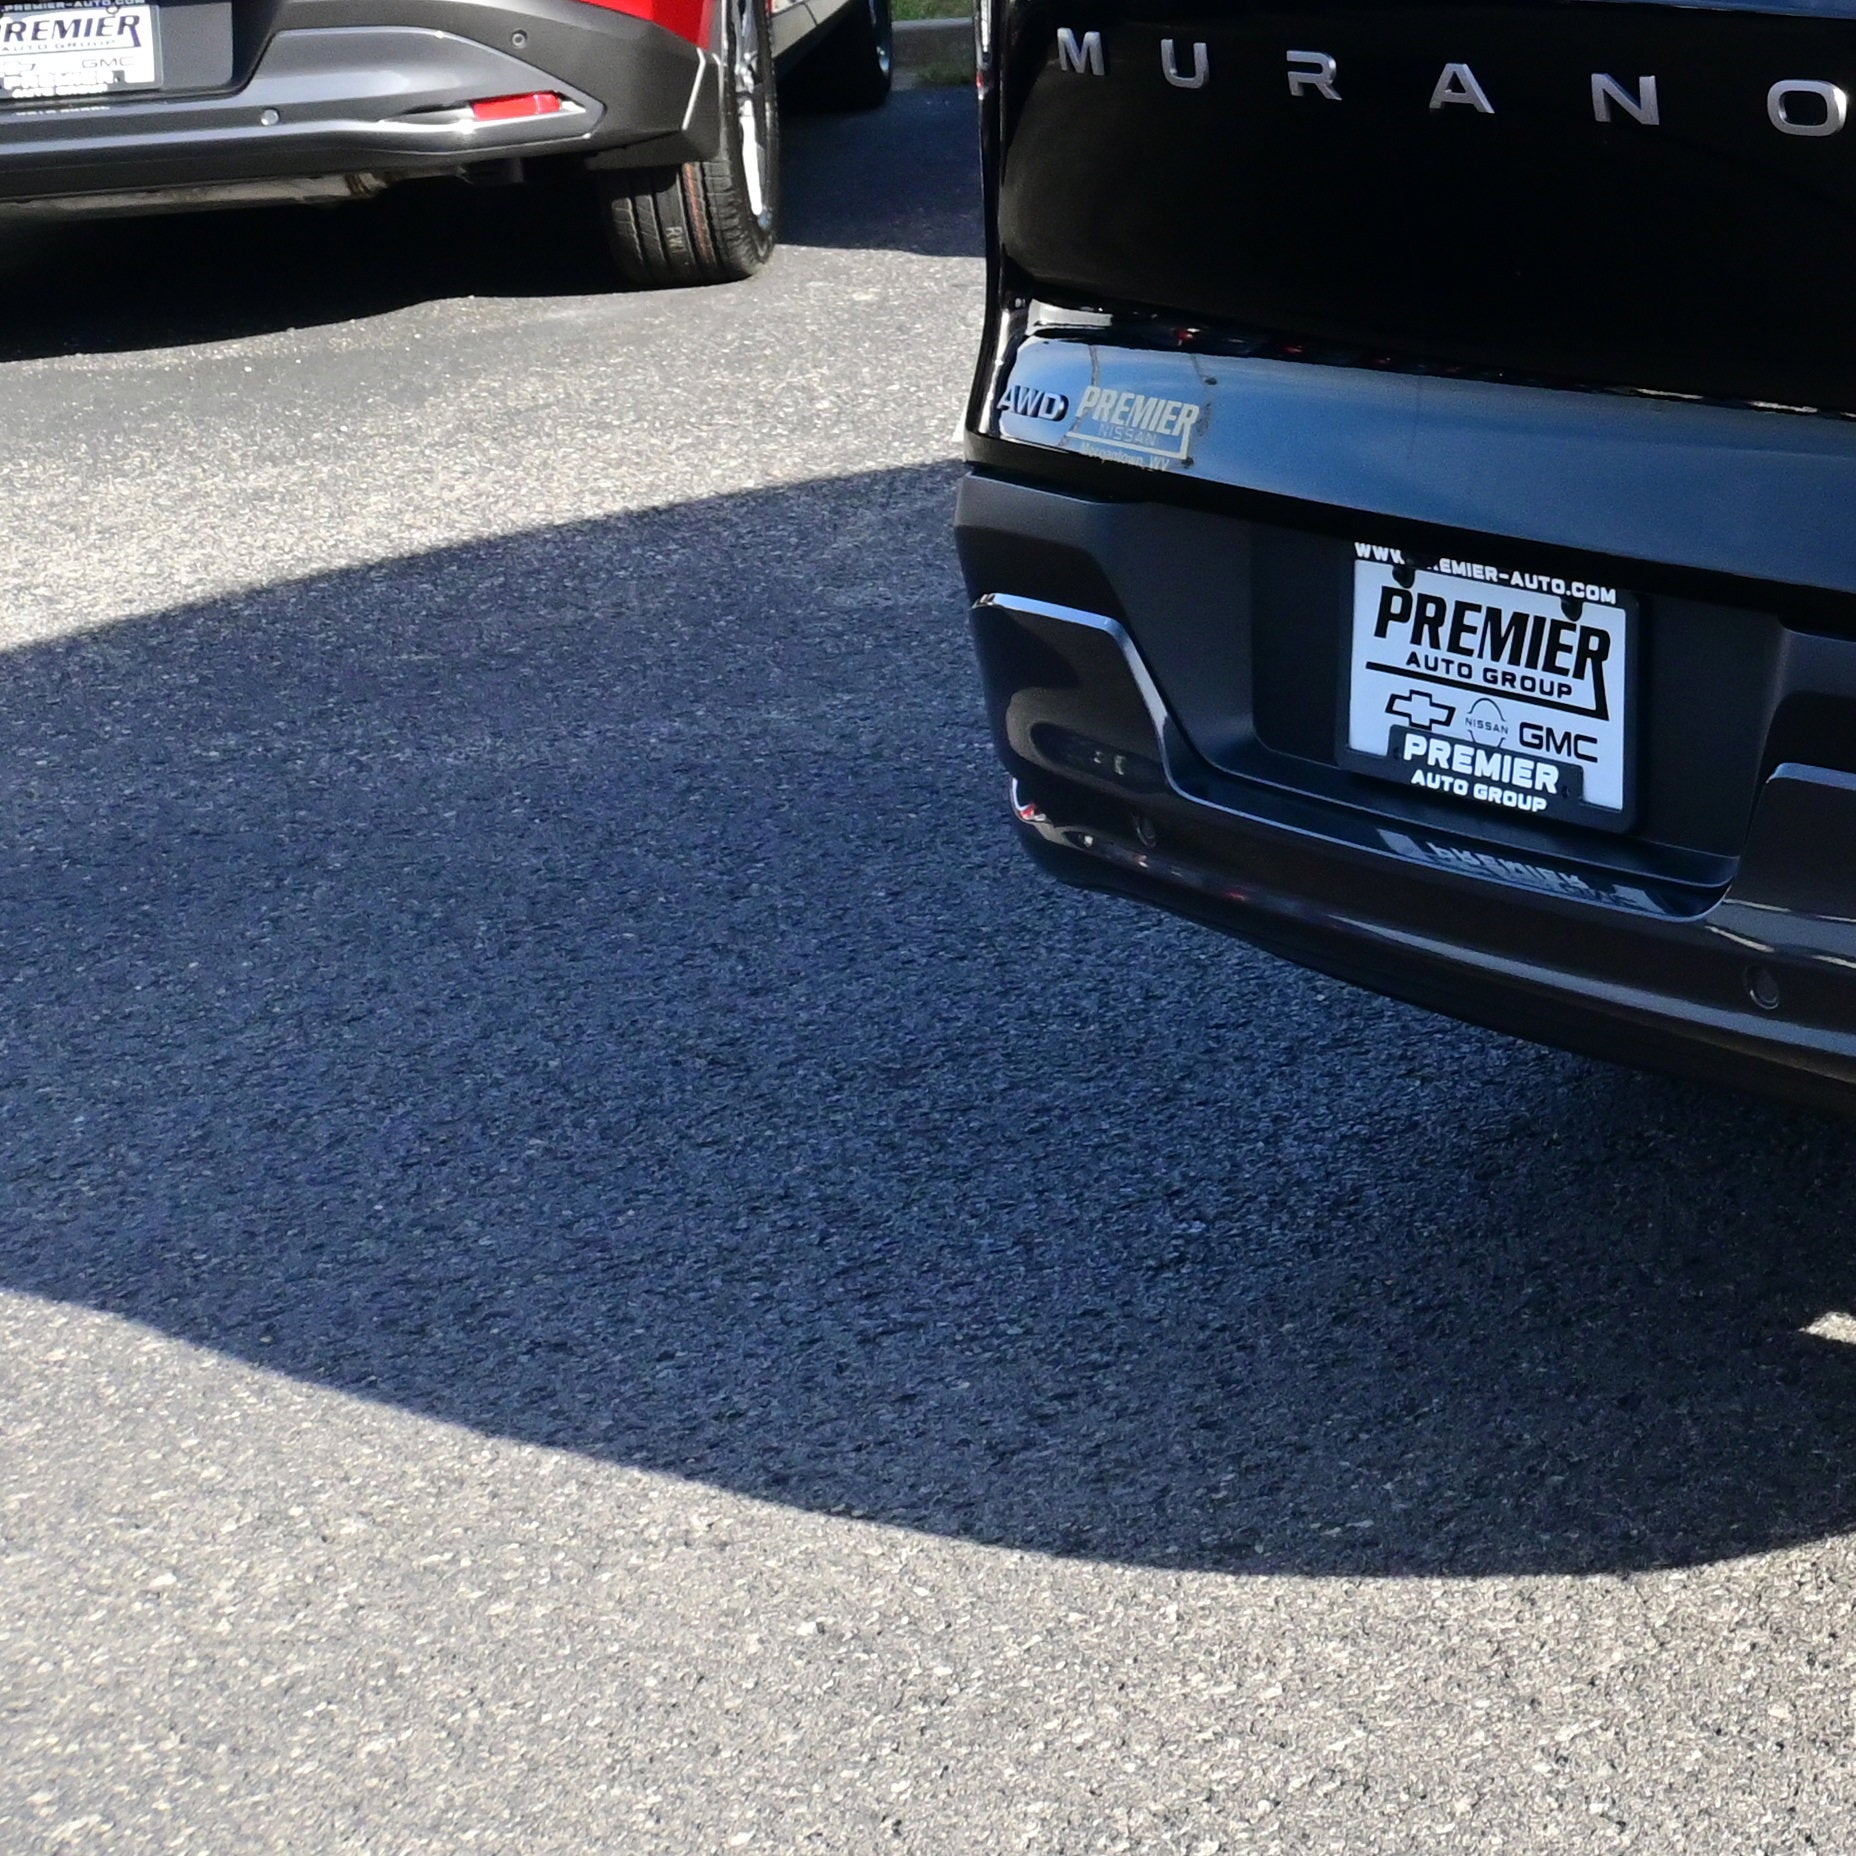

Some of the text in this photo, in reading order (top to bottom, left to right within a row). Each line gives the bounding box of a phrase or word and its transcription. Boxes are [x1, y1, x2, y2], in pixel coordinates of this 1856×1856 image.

[0, 15, 141, 47] REMIER
[1056, 26, 1848, 137] MURANO
[996, 385, 1069, 422] AWD
[1076, 385, 1200, 439] PREMIER
[1099, 423, 1158, 447] NISSAN
[1374, 585, 1612, 686] PREMIER
[1405, 650, 1573, 700] AUTO GROUP
[1403, 732, 1560, 795] PREMIER
[1464, 716, 1599, 764] NISSAN GMC
[1410, 768, 1548, 813] AUTO GROUP
